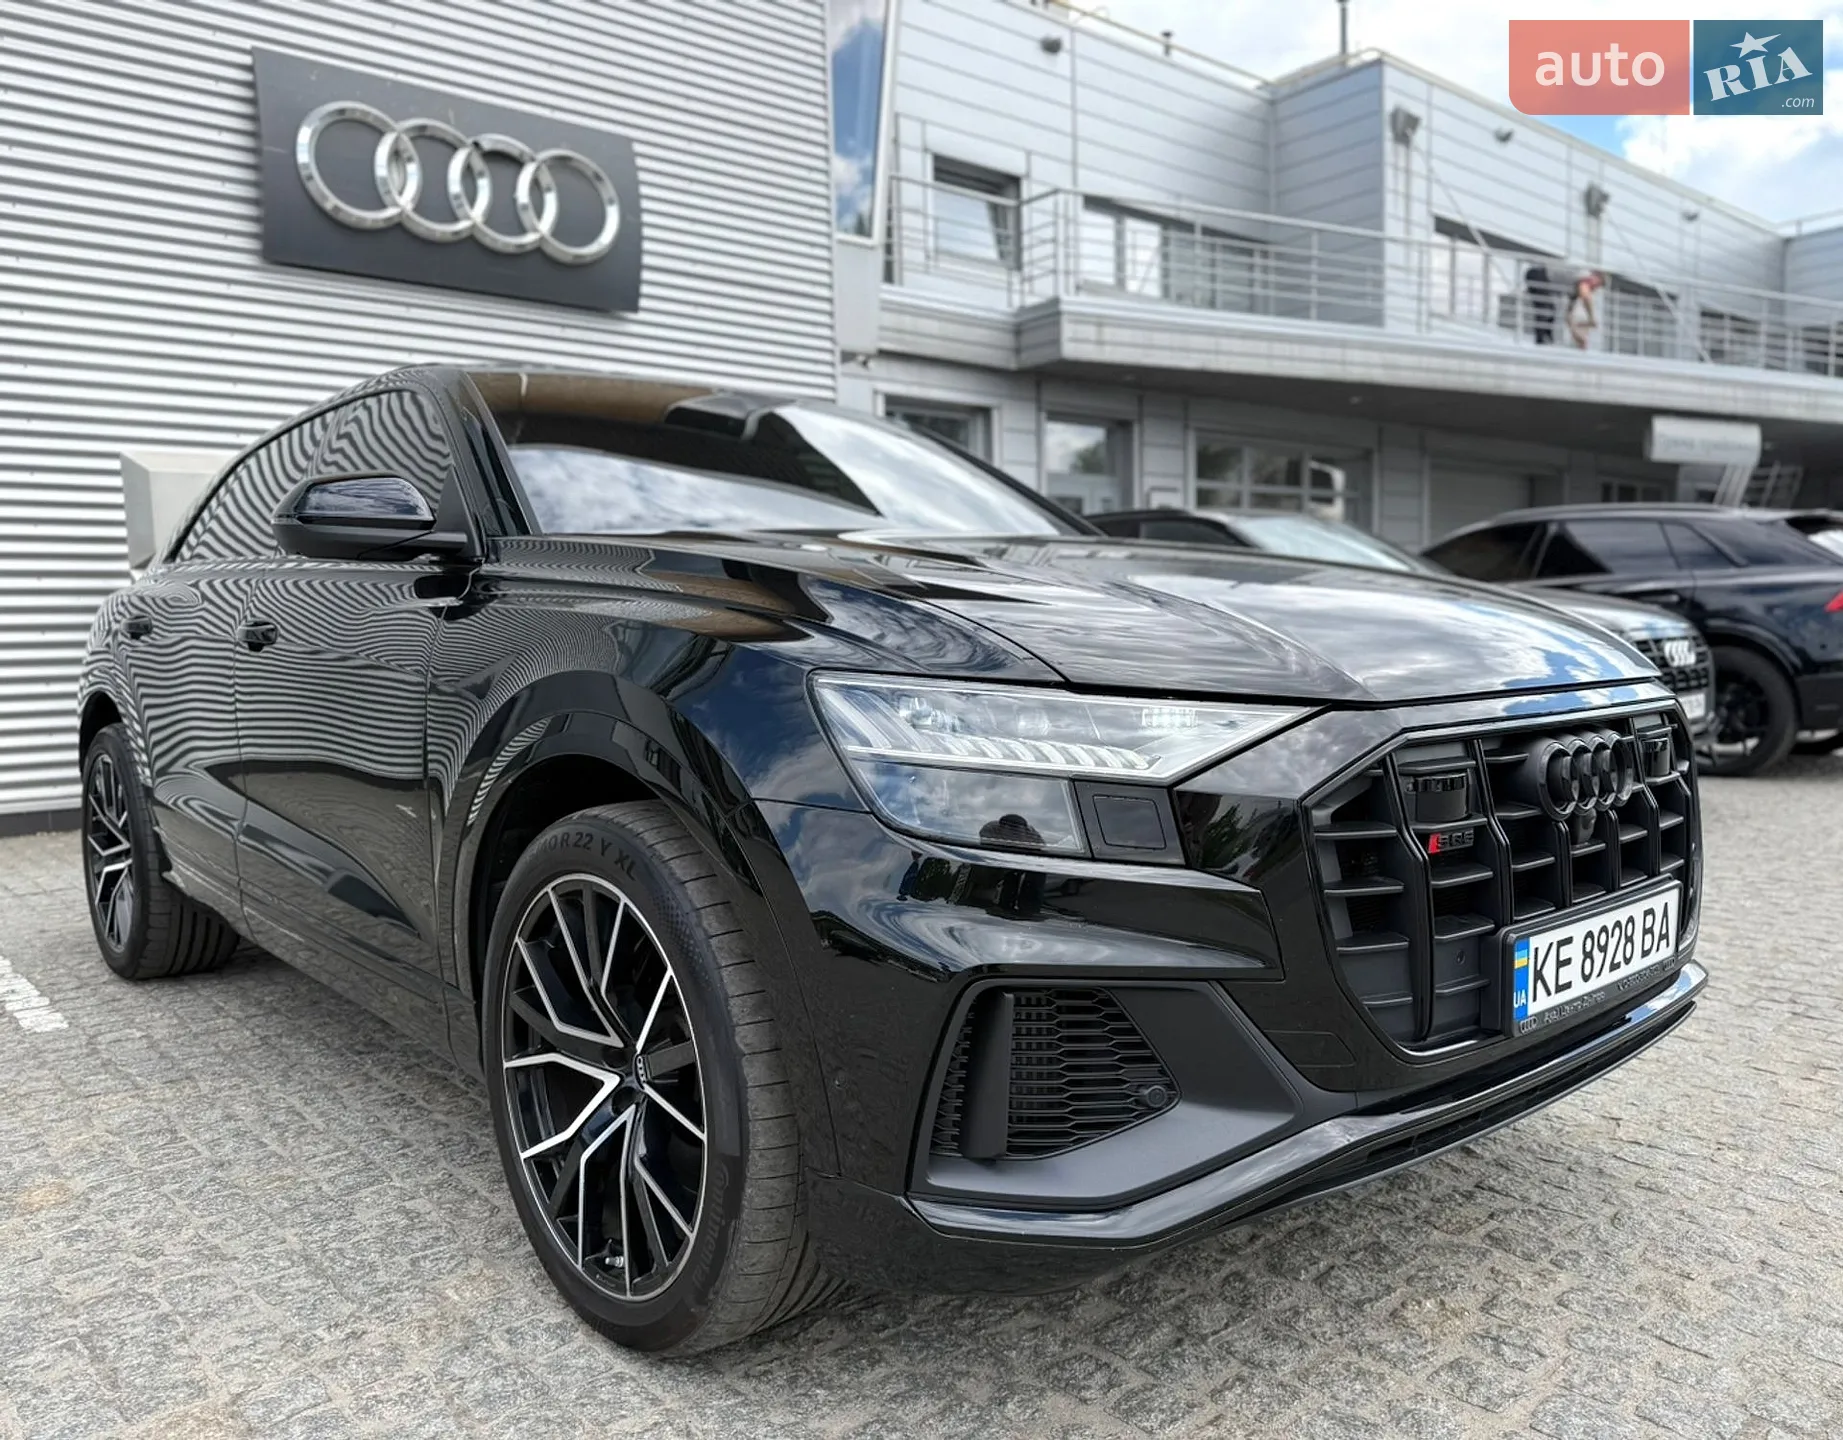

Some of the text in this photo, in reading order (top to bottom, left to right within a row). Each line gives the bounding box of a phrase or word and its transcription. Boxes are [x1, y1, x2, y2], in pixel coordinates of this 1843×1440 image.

[614, 848, 636, 881] XL
[1532, 902, 1670, 1002] KE 8928 BA
[1513, 991, 1527, 1008] UA
